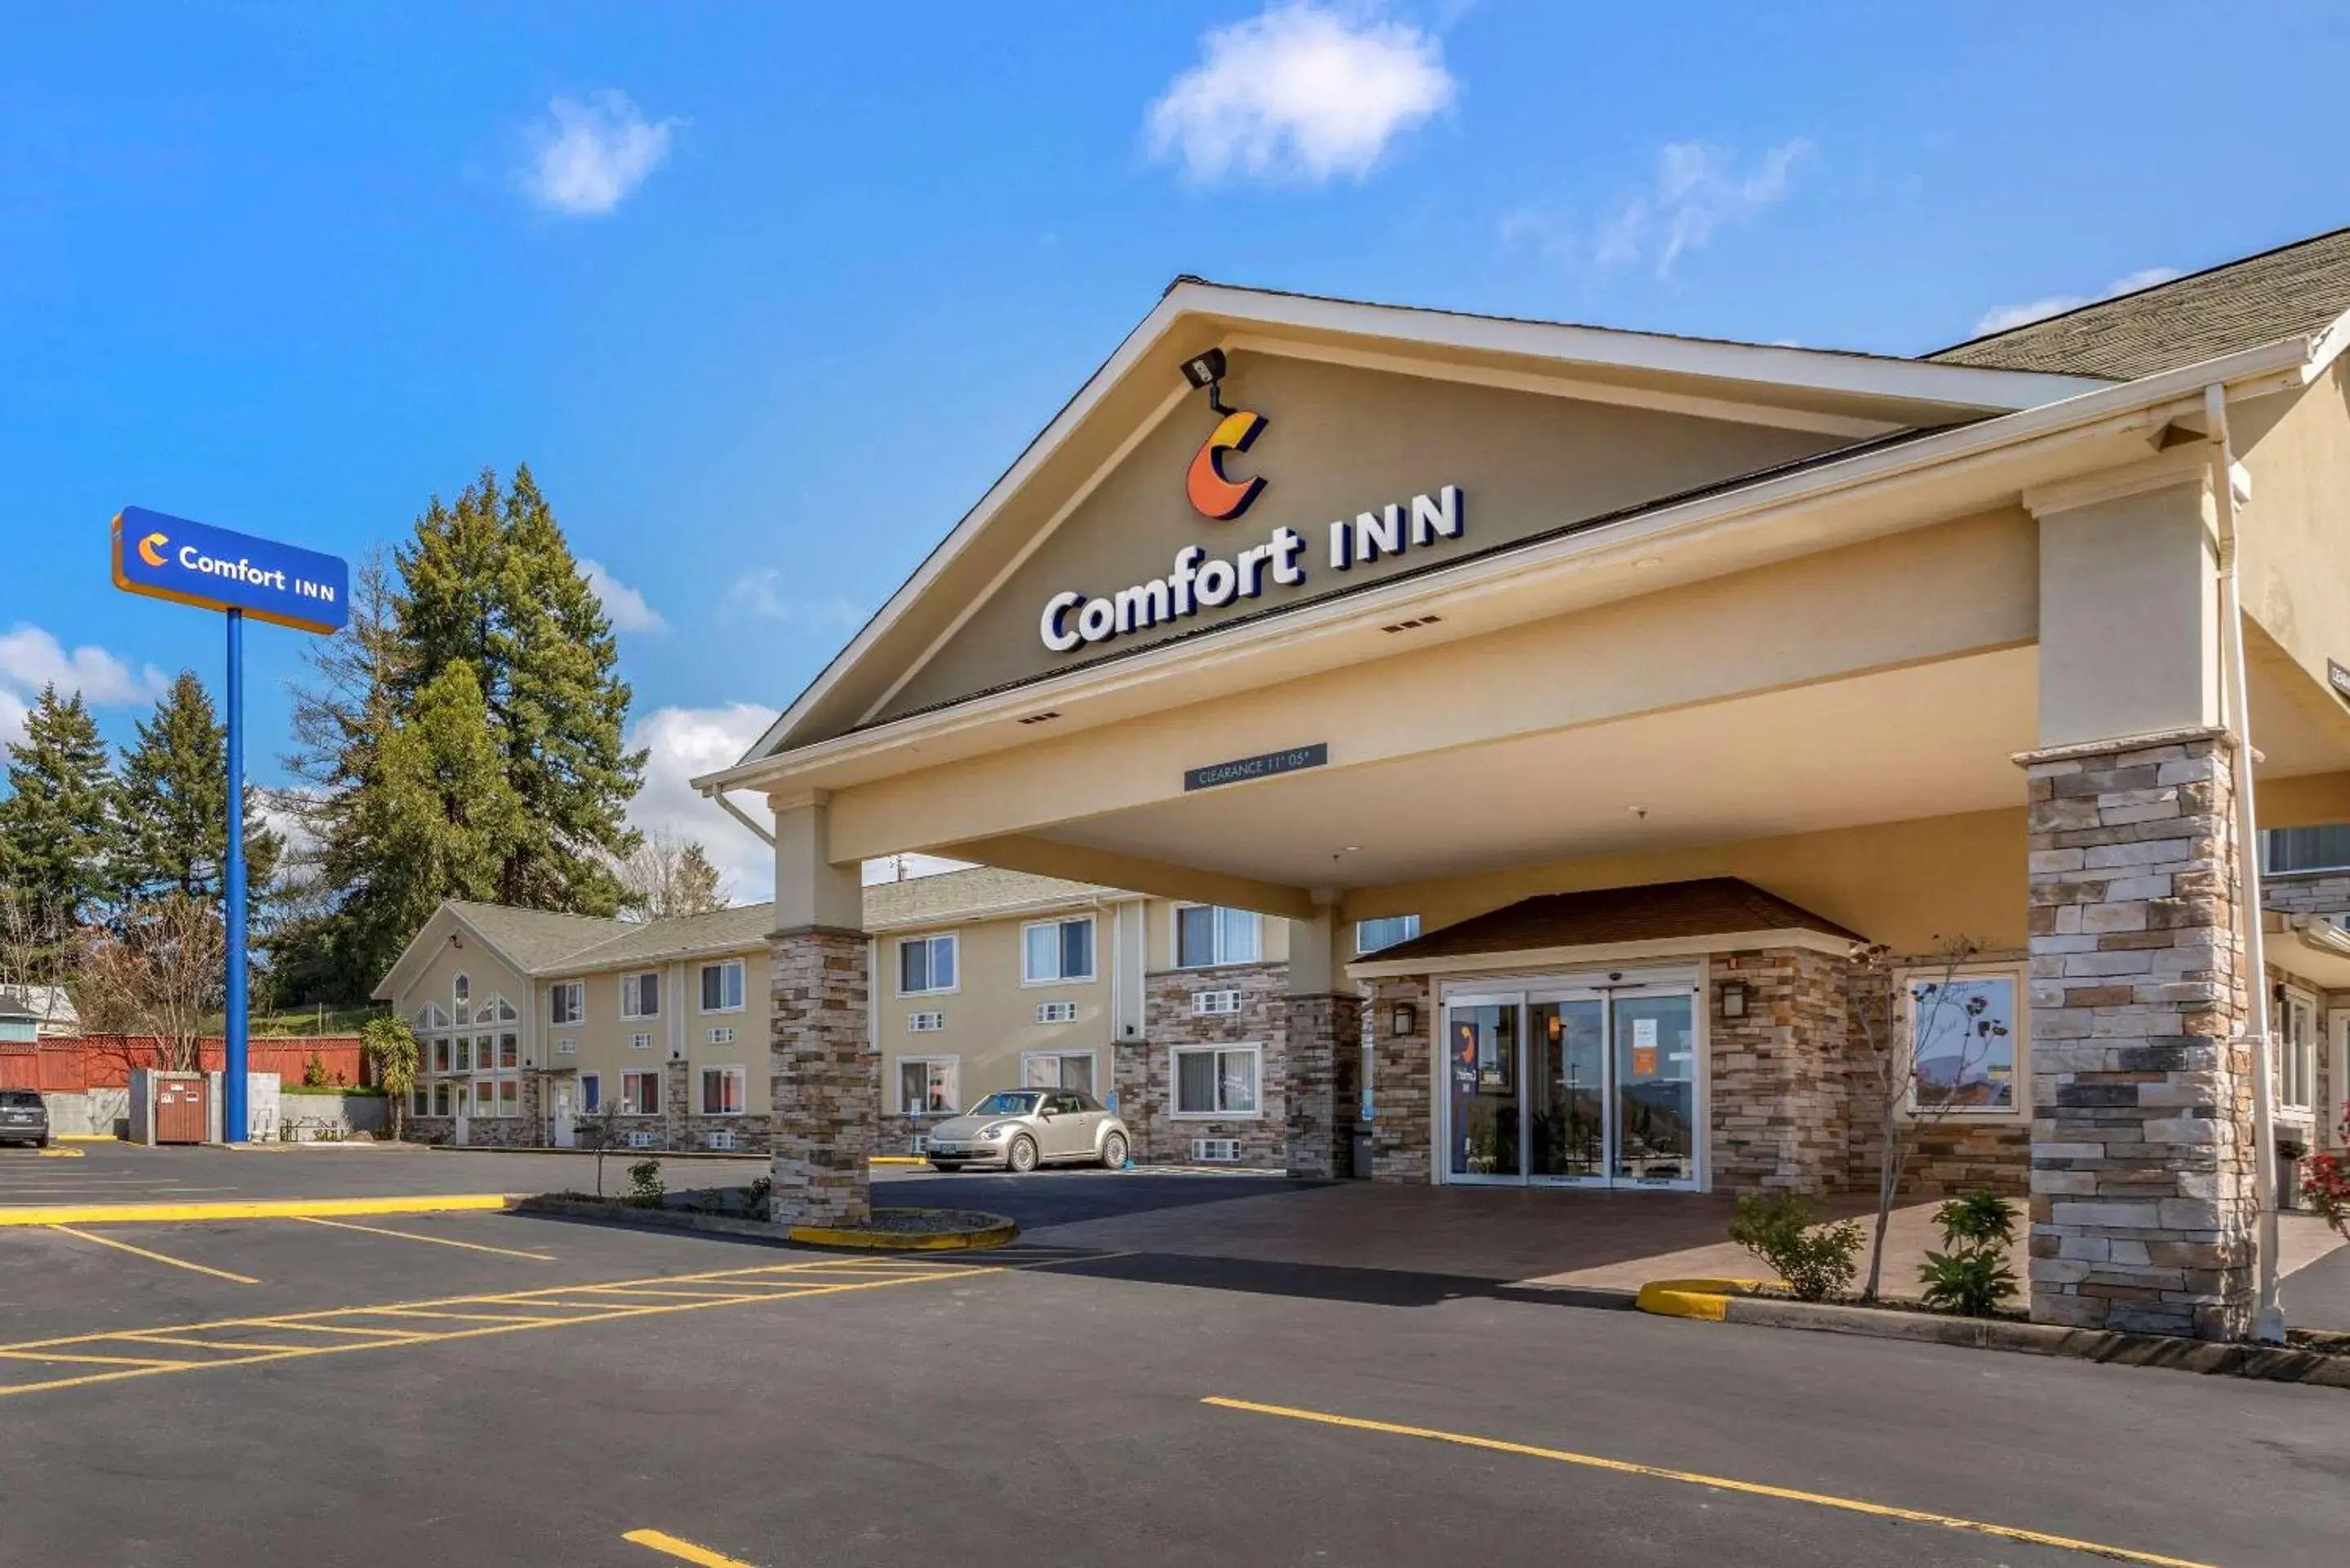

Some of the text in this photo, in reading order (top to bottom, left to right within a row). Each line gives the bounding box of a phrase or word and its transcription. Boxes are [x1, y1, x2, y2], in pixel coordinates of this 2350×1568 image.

[179, 546, 335, 602] Comfort INN
[1040, 485, 1464, 652] Comfort INN
[1199, 761, 1264, 784] CLEARANCE
